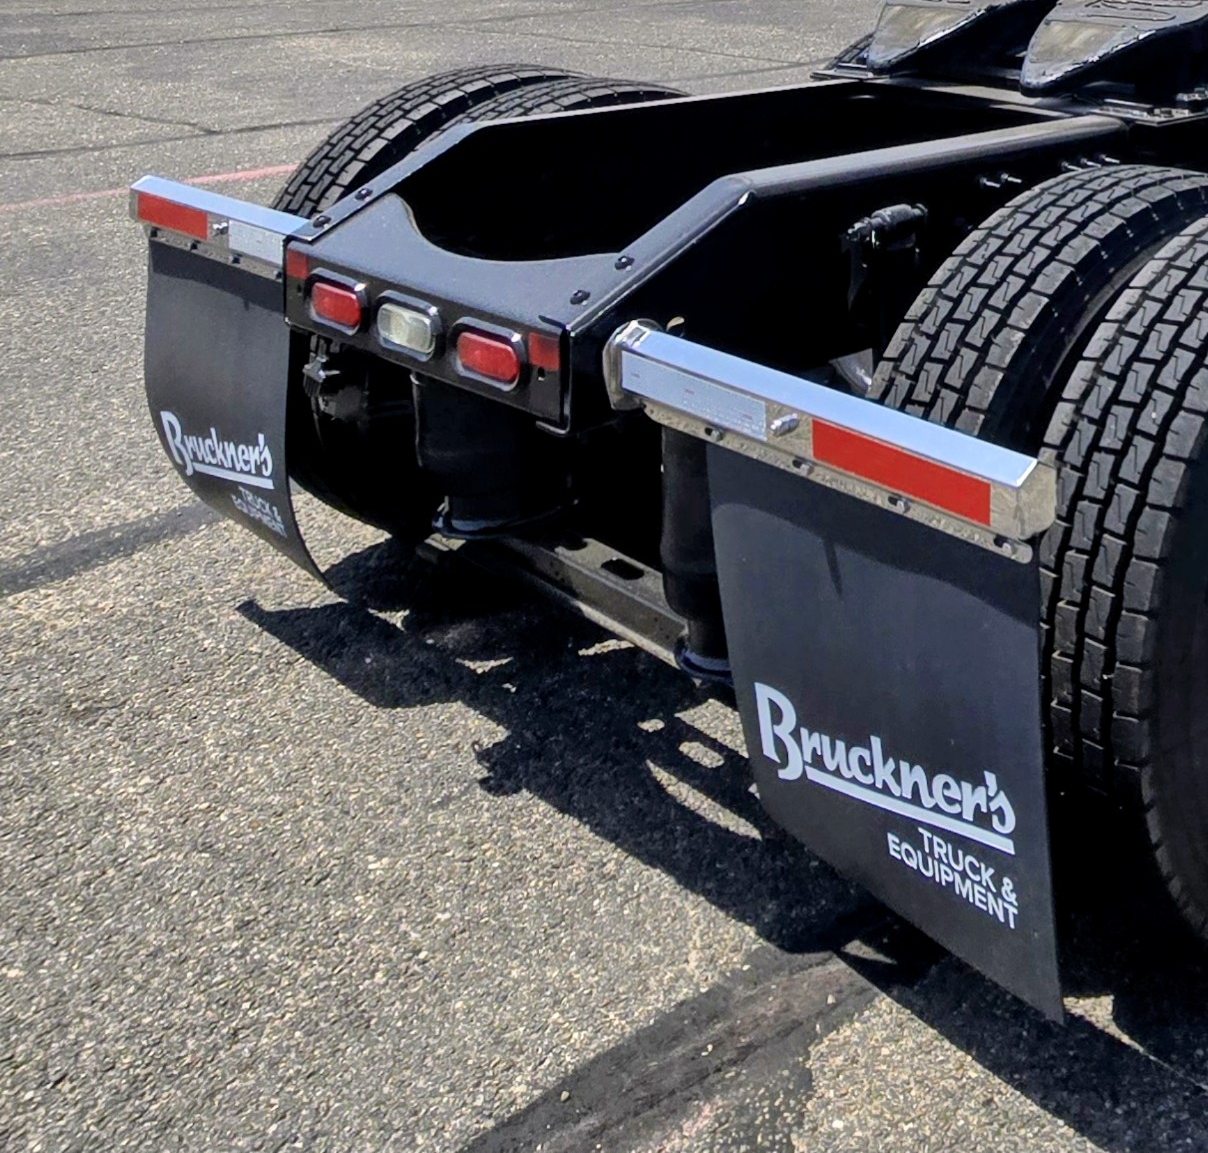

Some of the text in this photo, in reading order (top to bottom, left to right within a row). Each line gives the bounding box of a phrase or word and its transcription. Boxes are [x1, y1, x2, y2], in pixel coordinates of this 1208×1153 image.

[160, 410, 273, 477] Bruckner's
[754, 681, 1016, 834] Bruckner's
[886, 832, 1019, 930] EQUIPMENT
[917, 827, 1019, 907] TRUCK &
